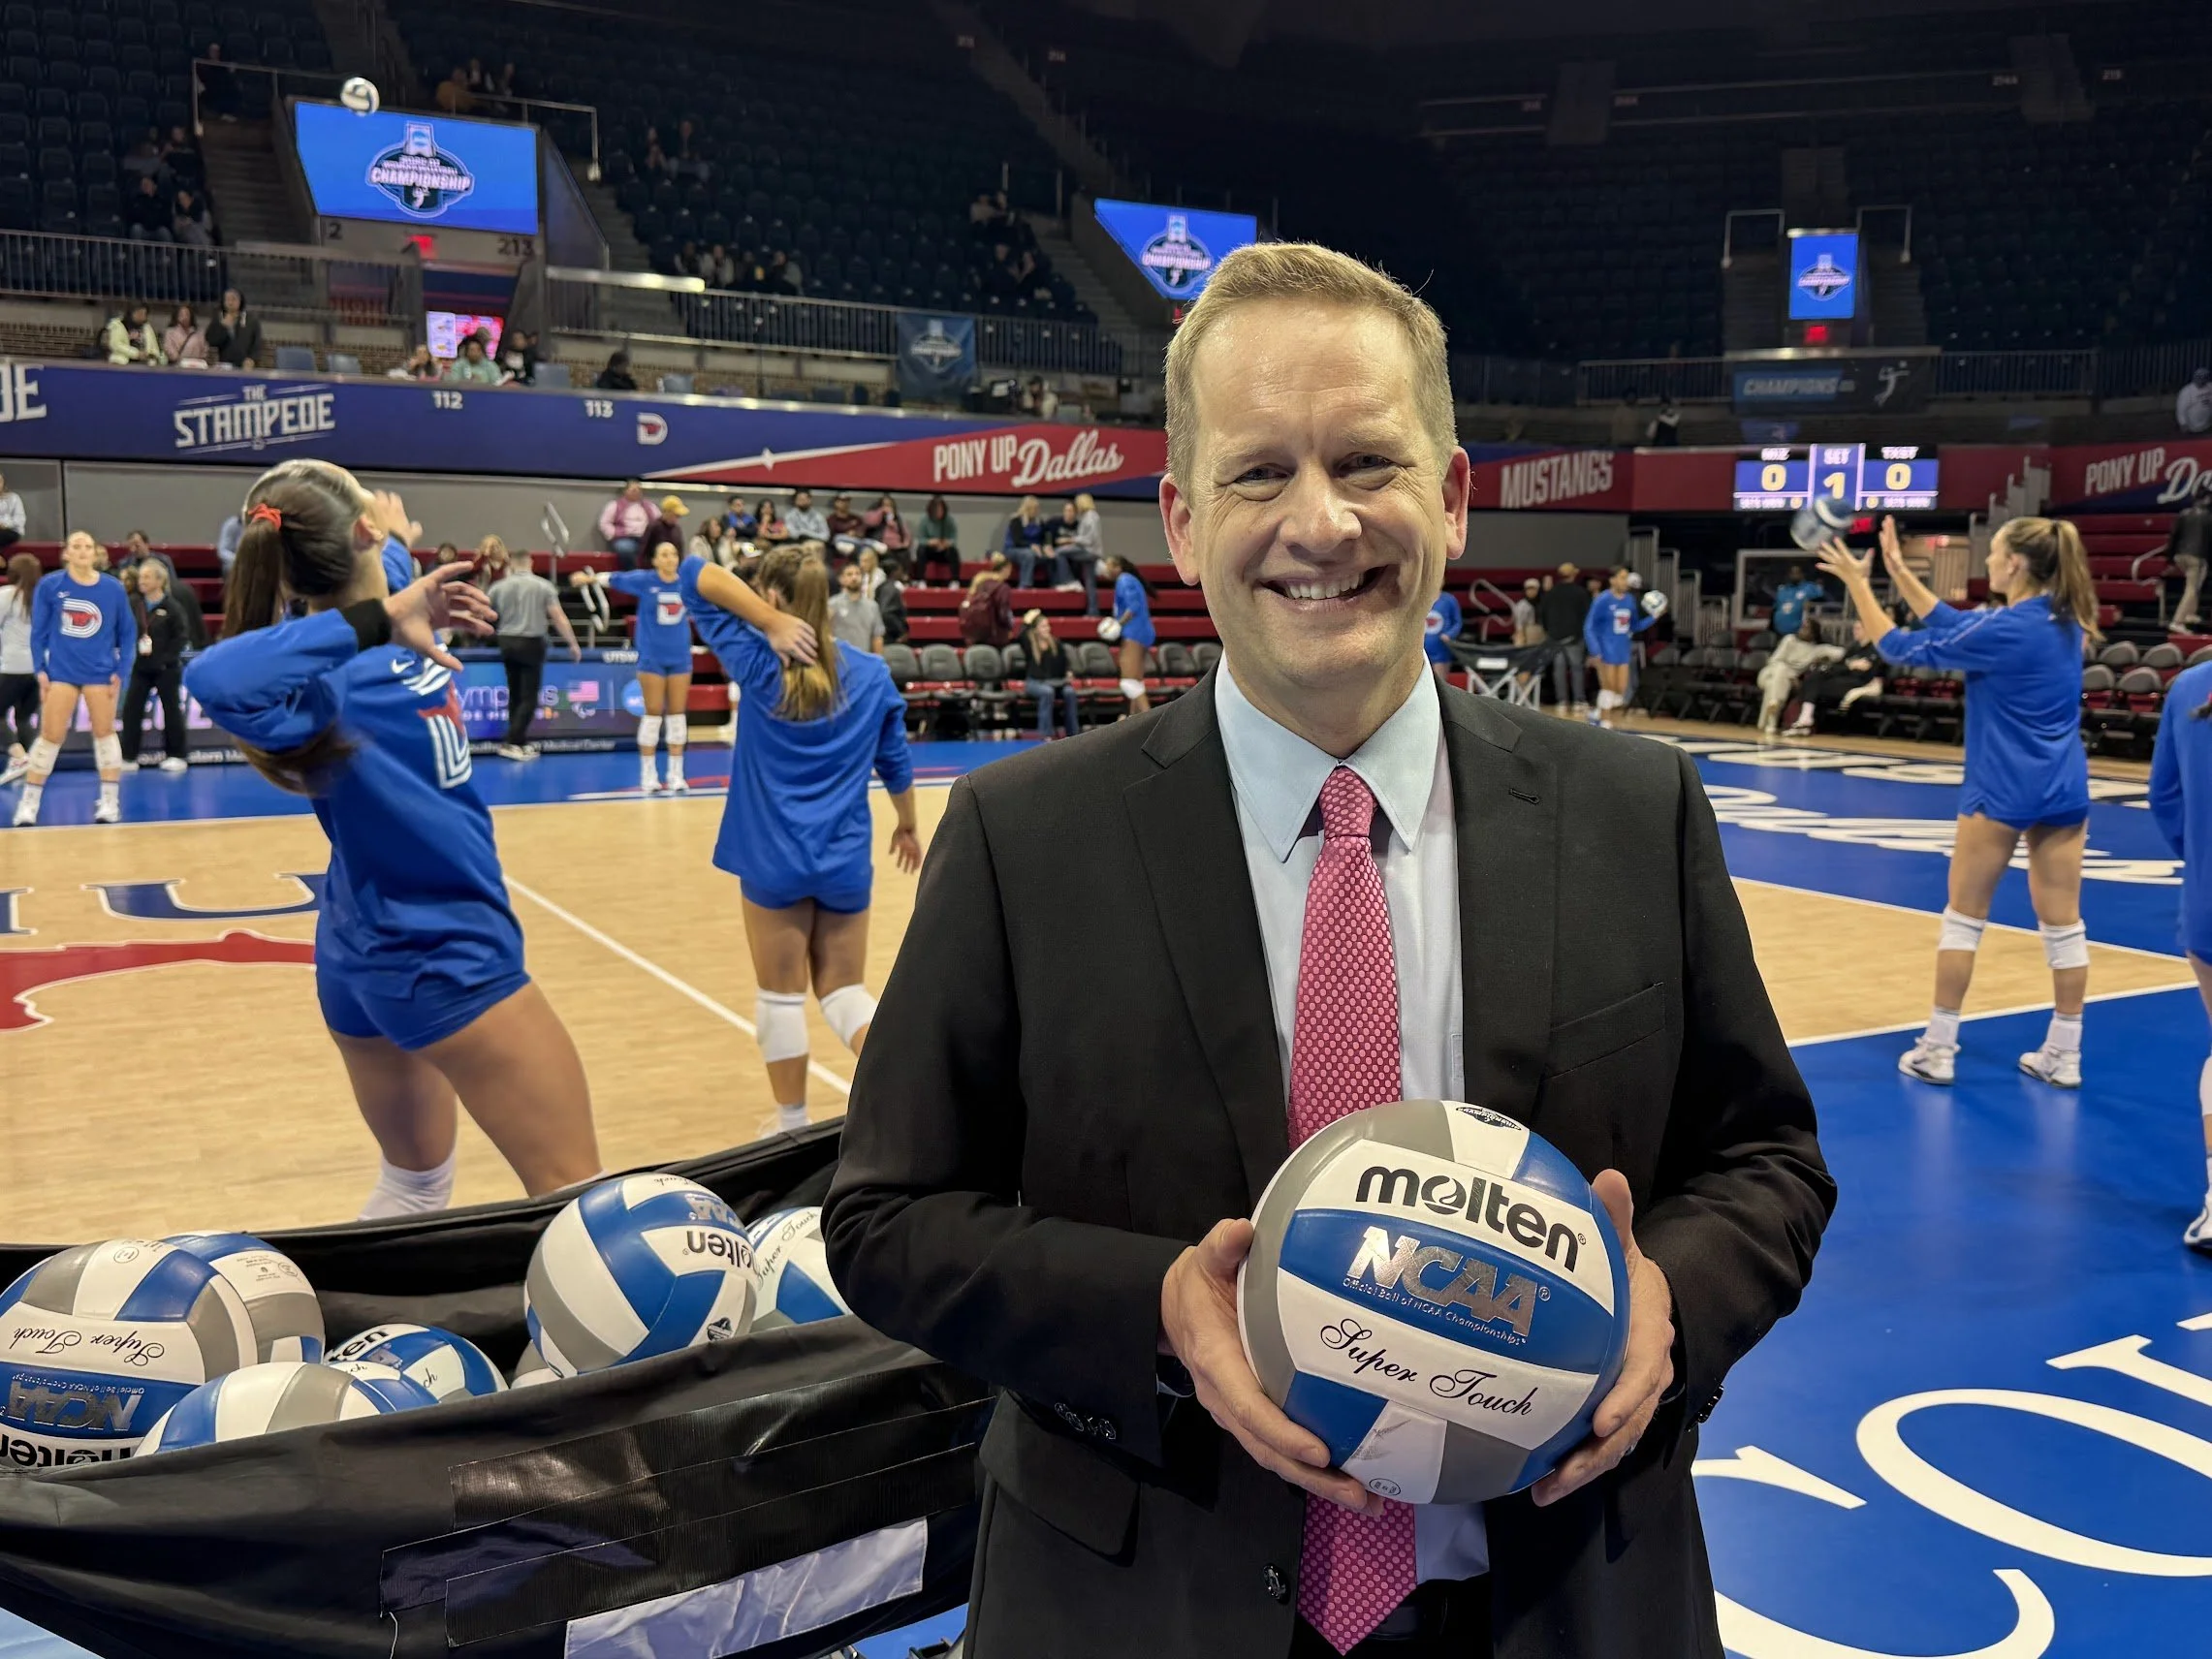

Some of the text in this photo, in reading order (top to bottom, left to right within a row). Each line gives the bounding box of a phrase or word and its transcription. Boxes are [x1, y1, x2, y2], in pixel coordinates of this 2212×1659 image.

[371, 166, 471, 191] CHAMPIONSHIP
[241, 384, 267, 401] THE
[432, 390, 463, 410] 112
[585, 399, 614, 419] 113
[173, 392, 335, 449] STAMPEDE
[933, 428, 1125, 488] PONY UP Dallas
[1500, 450, 1615, 510] MUSTANGS
[1760, 463, 1787, 492] 0
[1885, 462, 1912, 491] 0
[2084, 453, 2136, 497] PONY
[2137, 446, 2166, 485] UP
[1822, 471, 1847, 500] 1
[1355, 1166, 1579, 1273] molten
[1346, 1225, 1538, 1337] NCAA
[1343, 1277, 1521, 1346] Official Ball of NCAA Championships
[9, 1328, 165, 1366] Super Touch
[1320, 1318, 1539, 1416] Super Touch
[8, 1380, 142, 1431] NCAA
